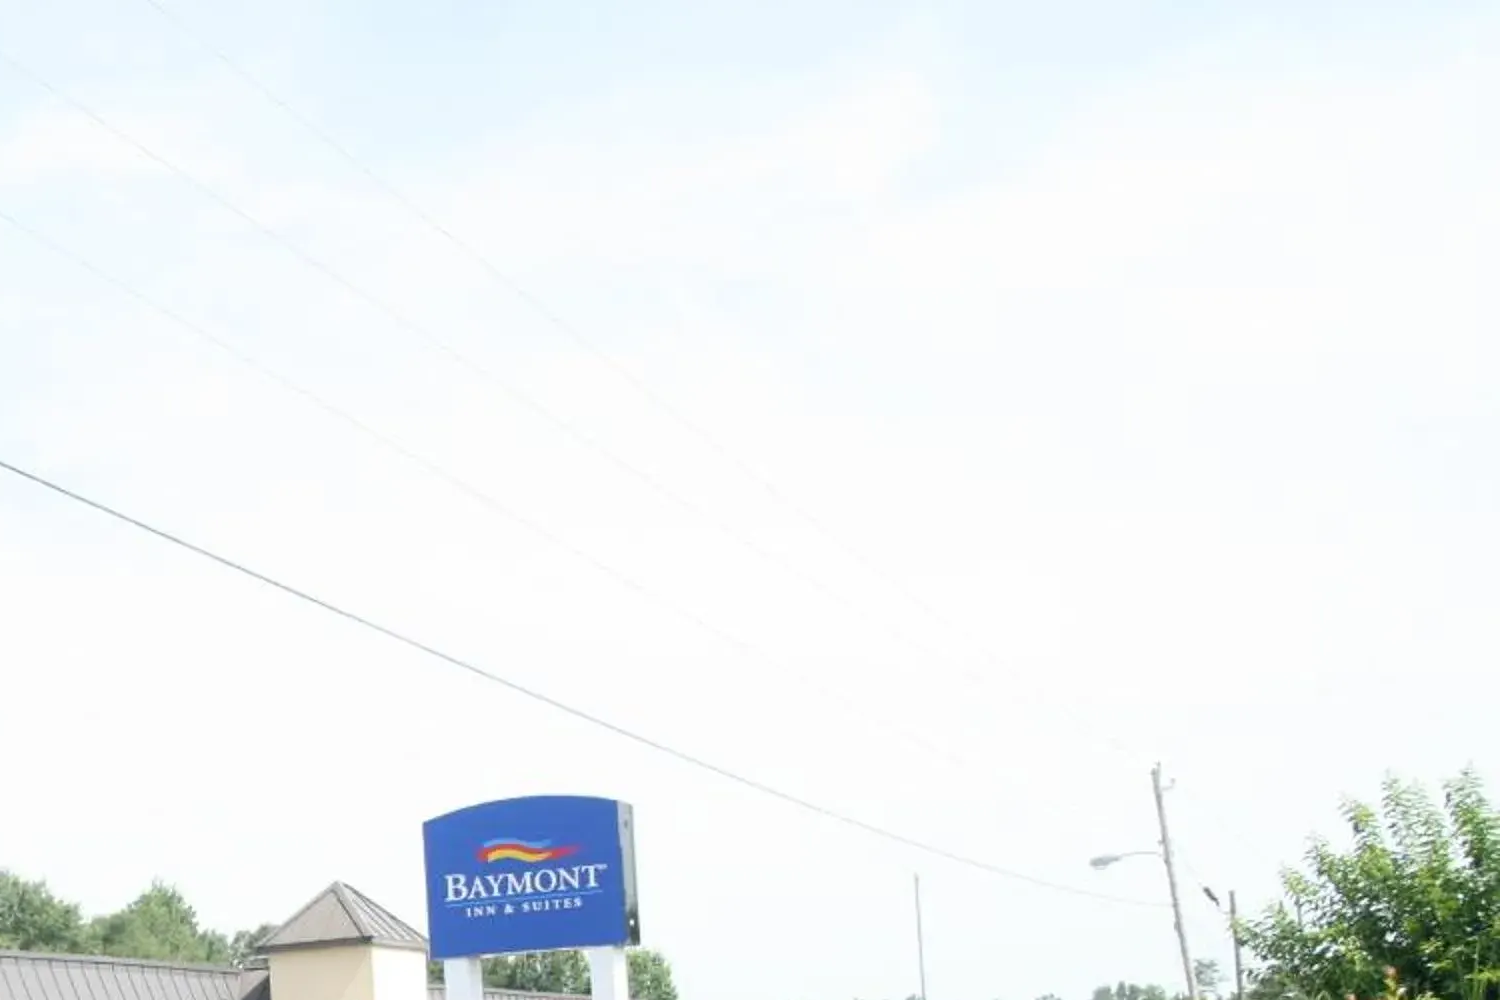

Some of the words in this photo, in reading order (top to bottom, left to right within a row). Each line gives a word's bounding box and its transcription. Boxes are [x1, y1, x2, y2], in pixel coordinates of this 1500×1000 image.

[444, 864, 603, 902] BAYMONT
[466, 905, 496, 919] INN
[504, 903, 515, 915] &
[522, 896, 583, 913] SUITES
